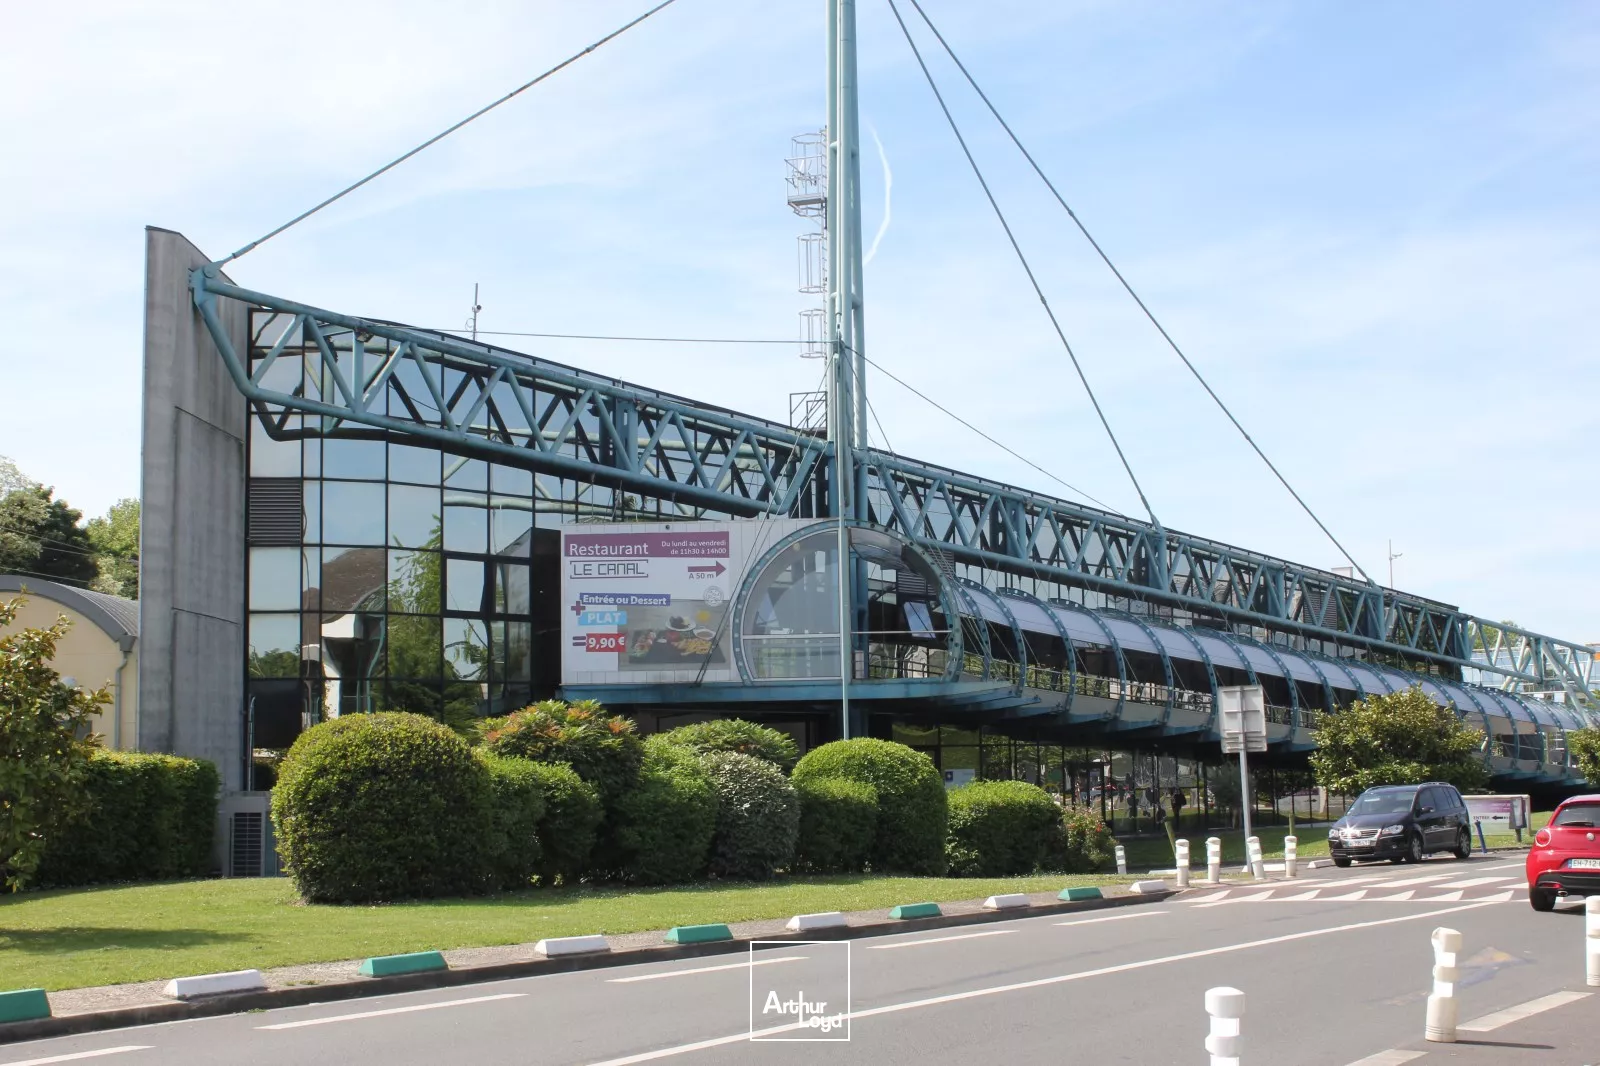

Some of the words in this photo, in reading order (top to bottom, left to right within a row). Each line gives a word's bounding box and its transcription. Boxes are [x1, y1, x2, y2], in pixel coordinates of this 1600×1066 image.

[569, 542, 649, 556] Restaurant
[573, 563, 593, 576] LE
[597, 562, 646, 576] CANAL
[696, 572, 706, 580] 50
[583, 594, 614, 604] Entrée
[630, 595, 667, 605] Dessert
[587, 612, 621, 624] PLAT
